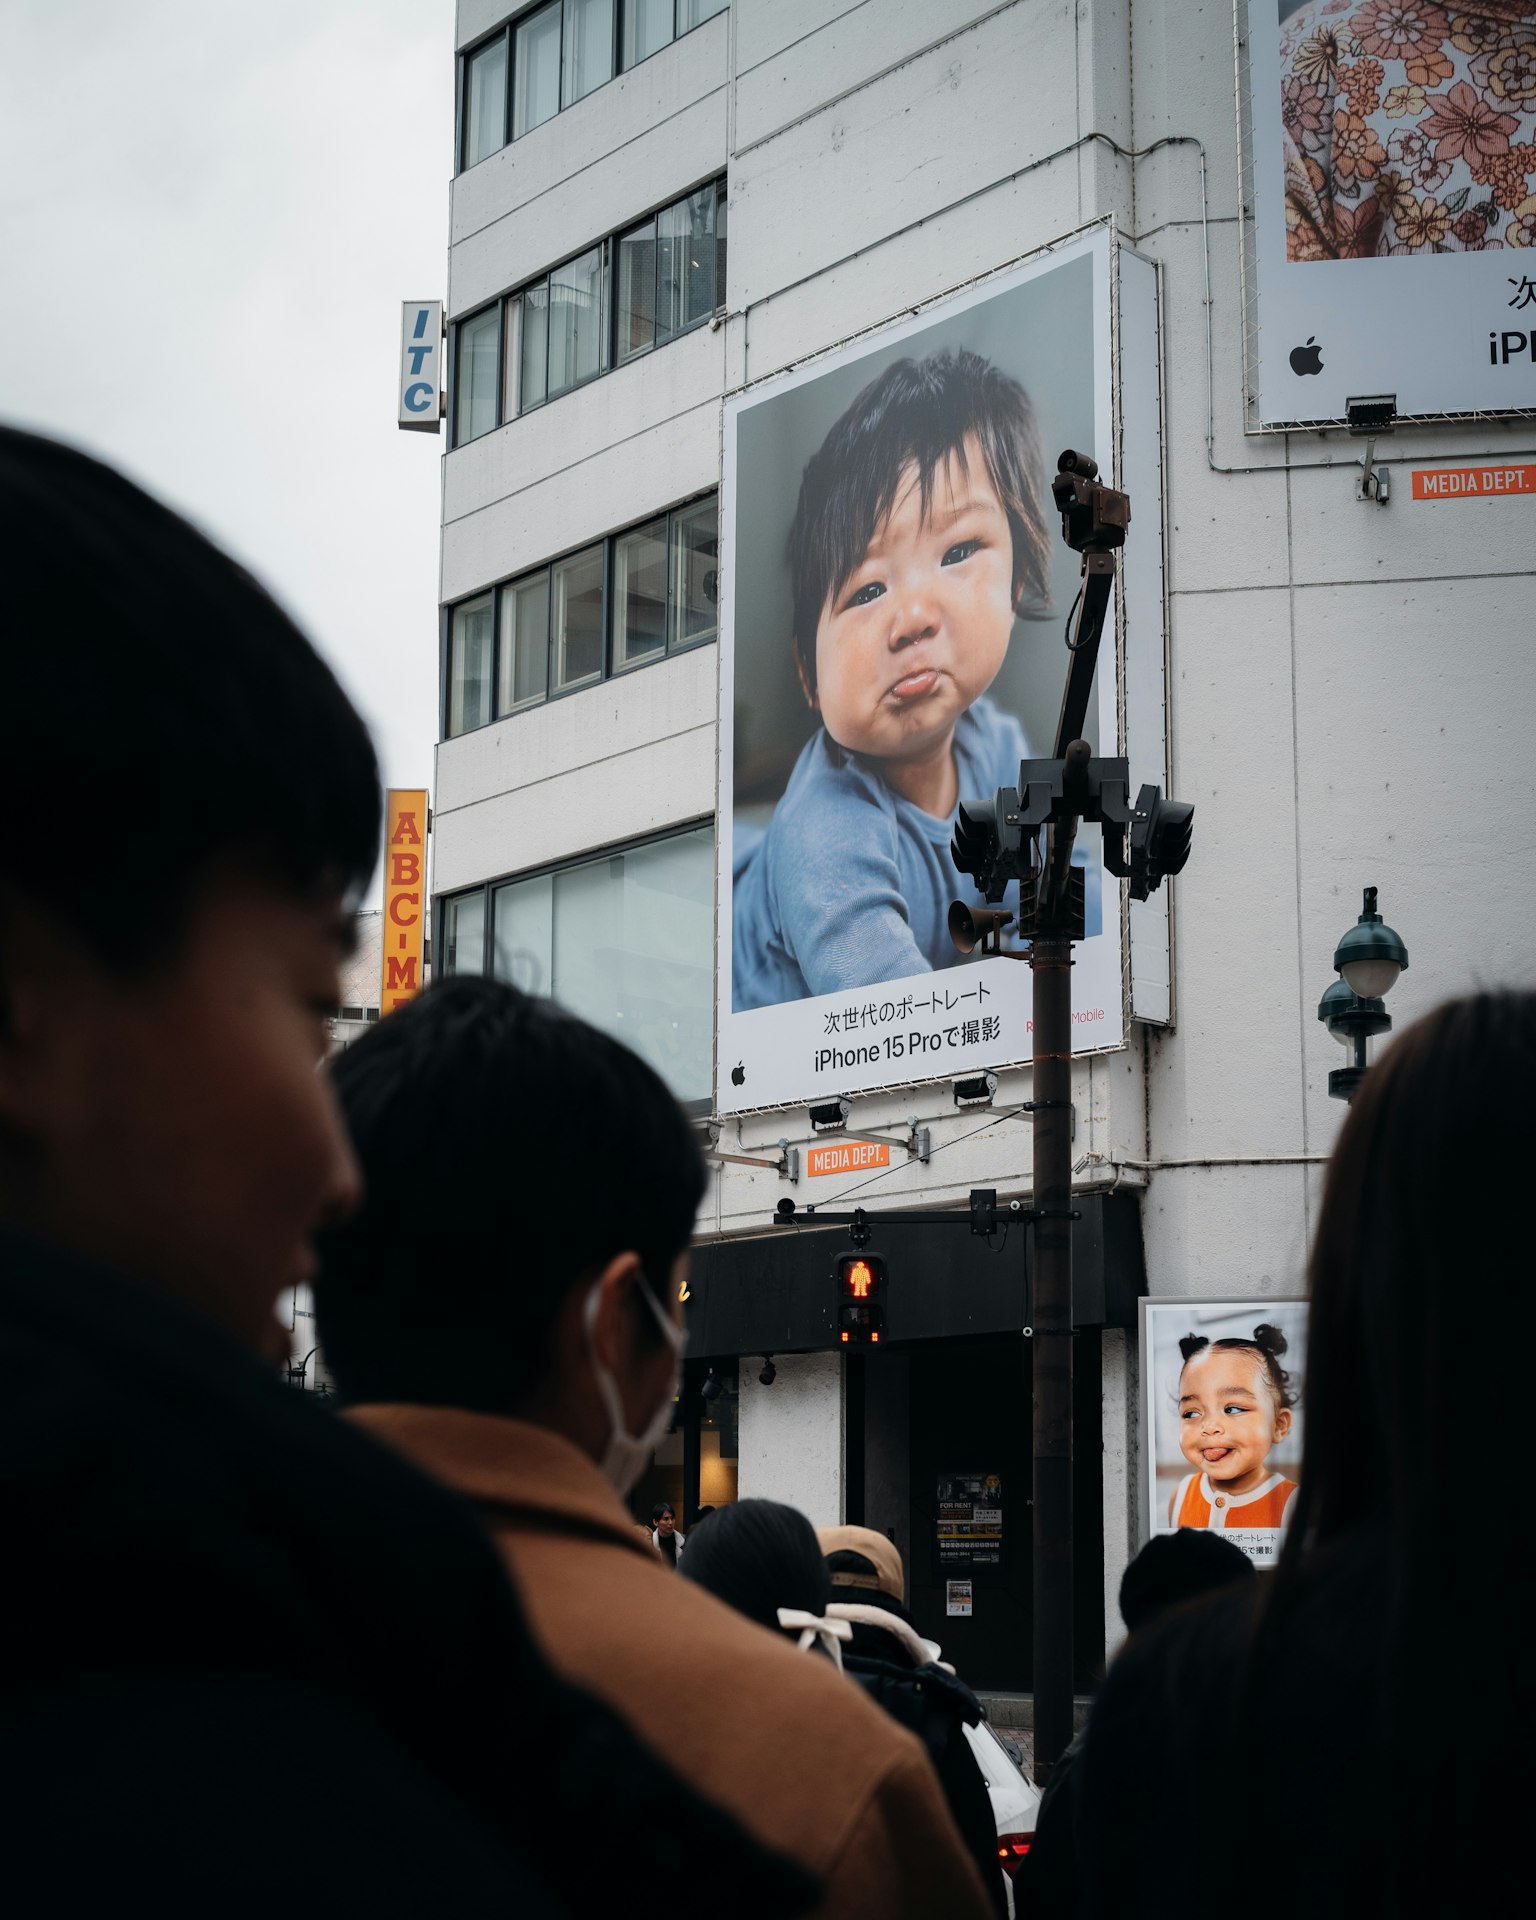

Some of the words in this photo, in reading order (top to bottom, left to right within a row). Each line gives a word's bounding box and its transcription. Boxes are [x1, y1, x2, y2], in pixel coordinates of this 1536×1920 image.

[404, 309, 434, 413] ITC
[1489, 329, 1536, 365] iP
[1422, 473, 1478, 494] MEDIA
[1482, 469, 1530, 491] DEPT.
[824, 981, 991, 1035] 次世代のポートレート
[1071, 1008, 1105, 1025] Mobile
[815, 1044, 880, 1072] iPhone
[882, 1034, 905, 1059] 15
[814, 1148, 850, 1172] MEDIA
[852, 1143, 884, 1165] DEPT.
